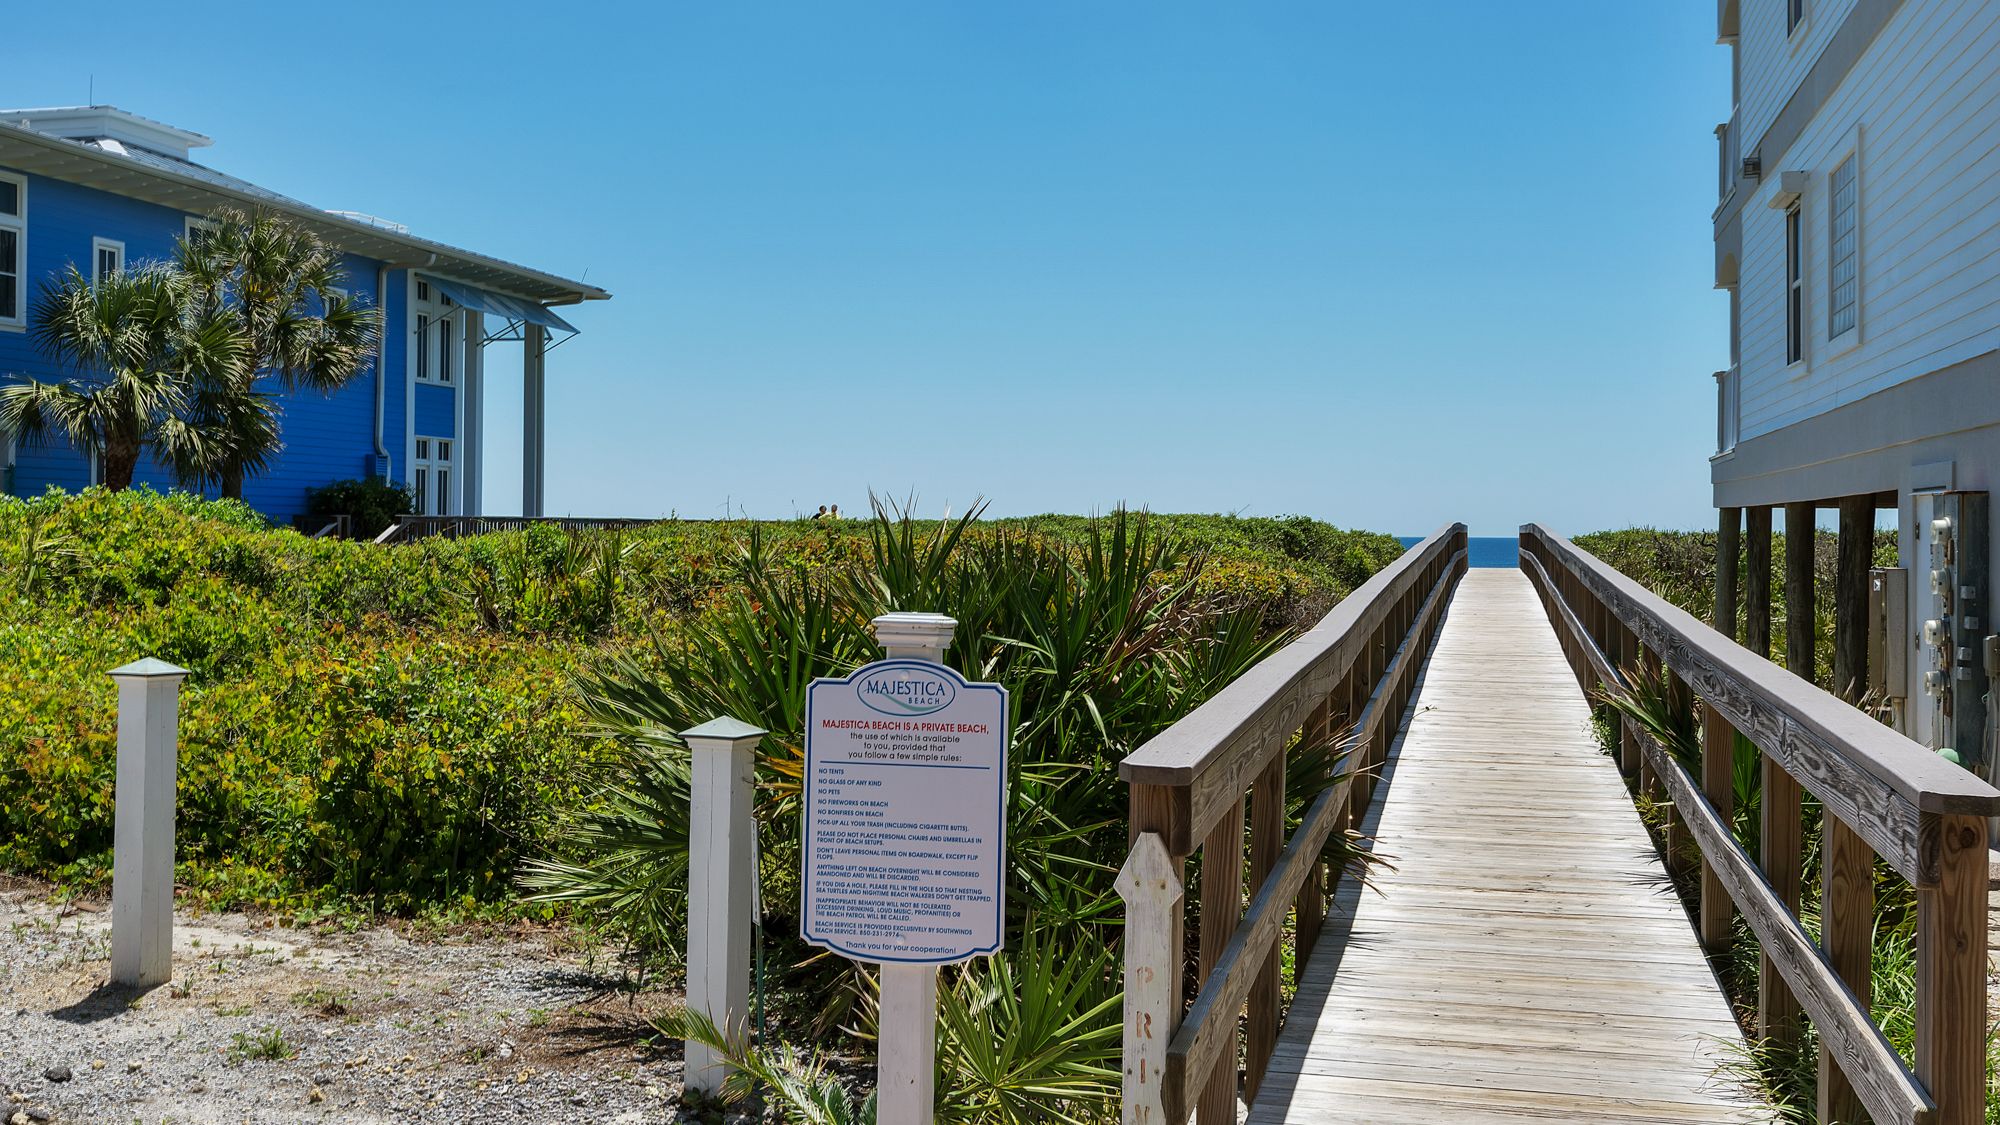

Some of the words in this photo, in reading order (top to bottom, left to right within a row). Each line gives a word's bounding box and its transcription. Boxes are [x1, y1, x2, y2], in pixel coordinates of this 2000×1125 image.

[867, 679, 945, 696] MAJESTICA
[908, 696, 939, 705] BEACH
[822, 719, 870, 729] MAJESTICA
[872, 720, 900, 730] BEACH
[903, 721, 910, 731] IS
[912, 722, 919, 731] A
[921, 722, 954, 732] PRIVATE
[957, 723, 988, 734] BEACH,
[879, 732, 888, 740] of
[889, 733, 912, 741] which
[922, 734, 960, 743] available
[892, 742, 928, 751] provided
[929, 743, 945, 752] that
[864, 750, 887, 759] follow
[912, 752, 938, 761] simple
[908, 851, 944, 859] BOARDWALK,
[942, 869, 979, 877] CONSIDERED
[920, 902, 951, 910] TOLERATED
[914, 908, 951, 917] PROFANITIES)
[892, 924, 927, 932] EXCLUSIVELY
[935, 927, 972, 935] SOUTHWINDS
[845, 940, 866, 948] Thank
[909, 945, 956, 954] cooperation!
